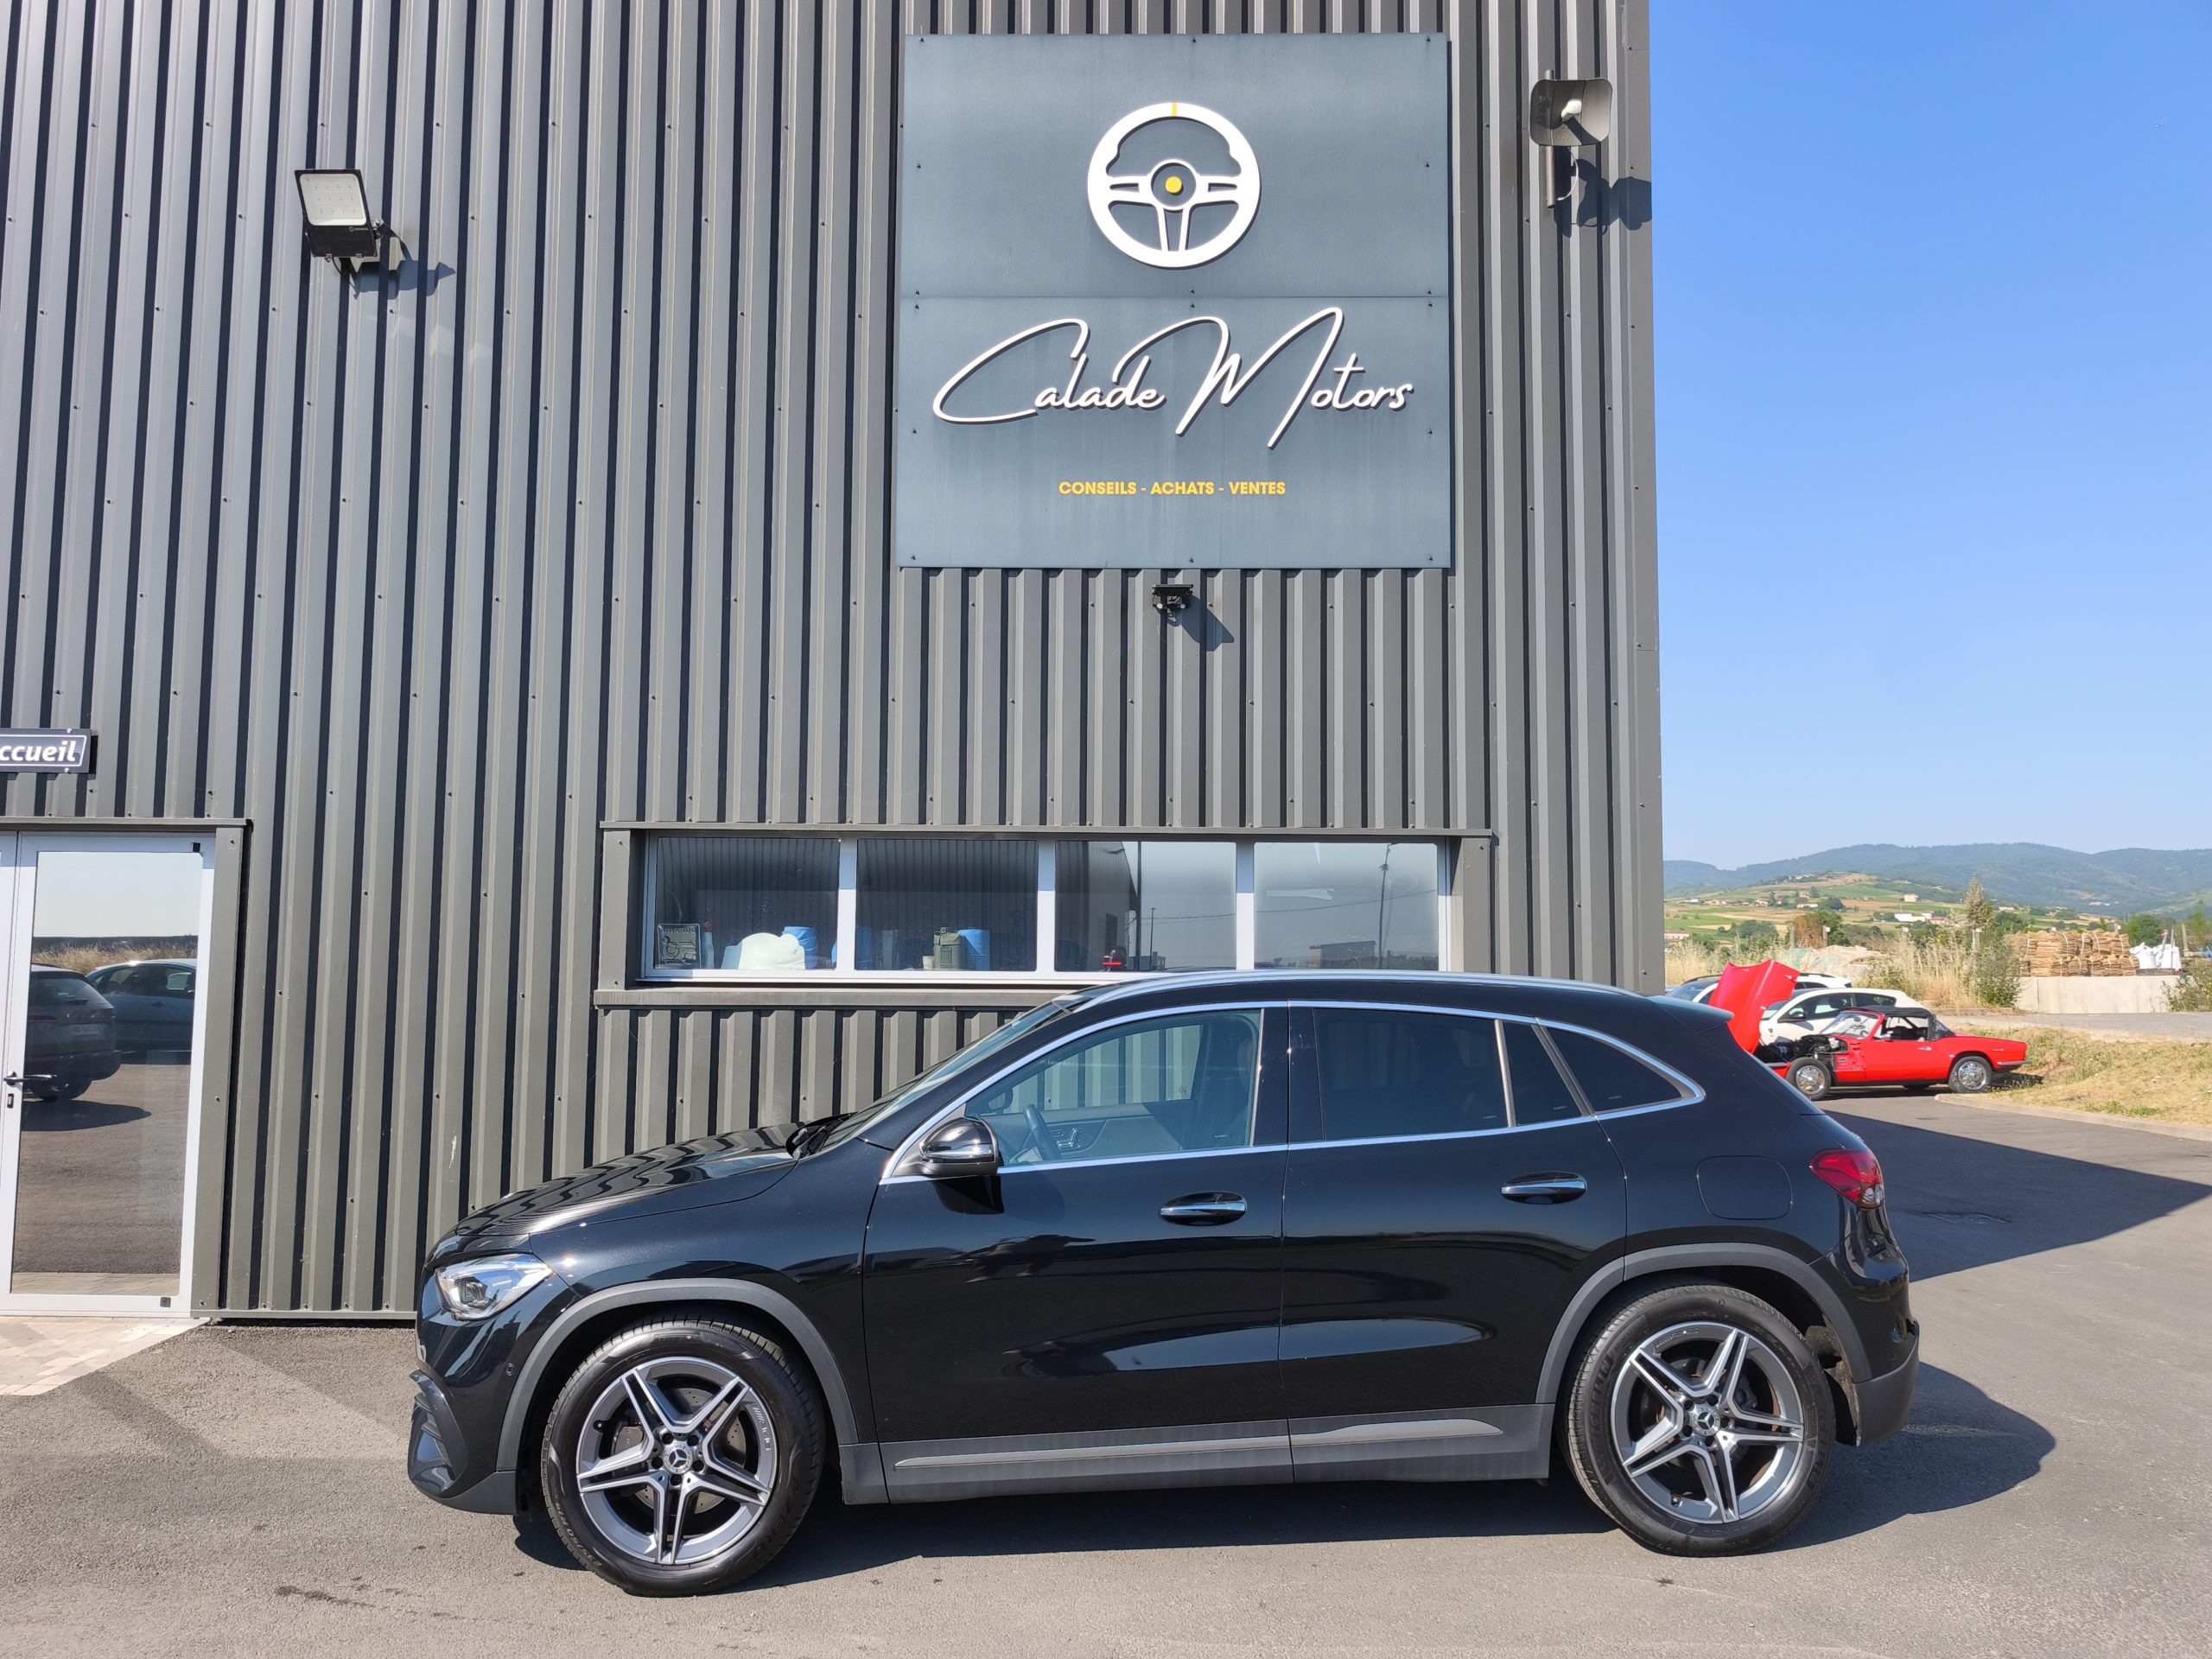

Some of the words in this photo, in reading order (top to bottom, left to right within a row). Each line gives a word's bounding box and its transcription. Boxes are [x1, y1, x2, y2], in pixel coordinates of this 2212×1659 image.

[932, 317, 1166, 423] Calade
[1111, 306, 1414, 448] Motors
[1058, 480, 1138, 496] CONSEILS
[1150, 480, 1215, 496] ACHATS
[1229, 480, 1287, 496] VENTES
